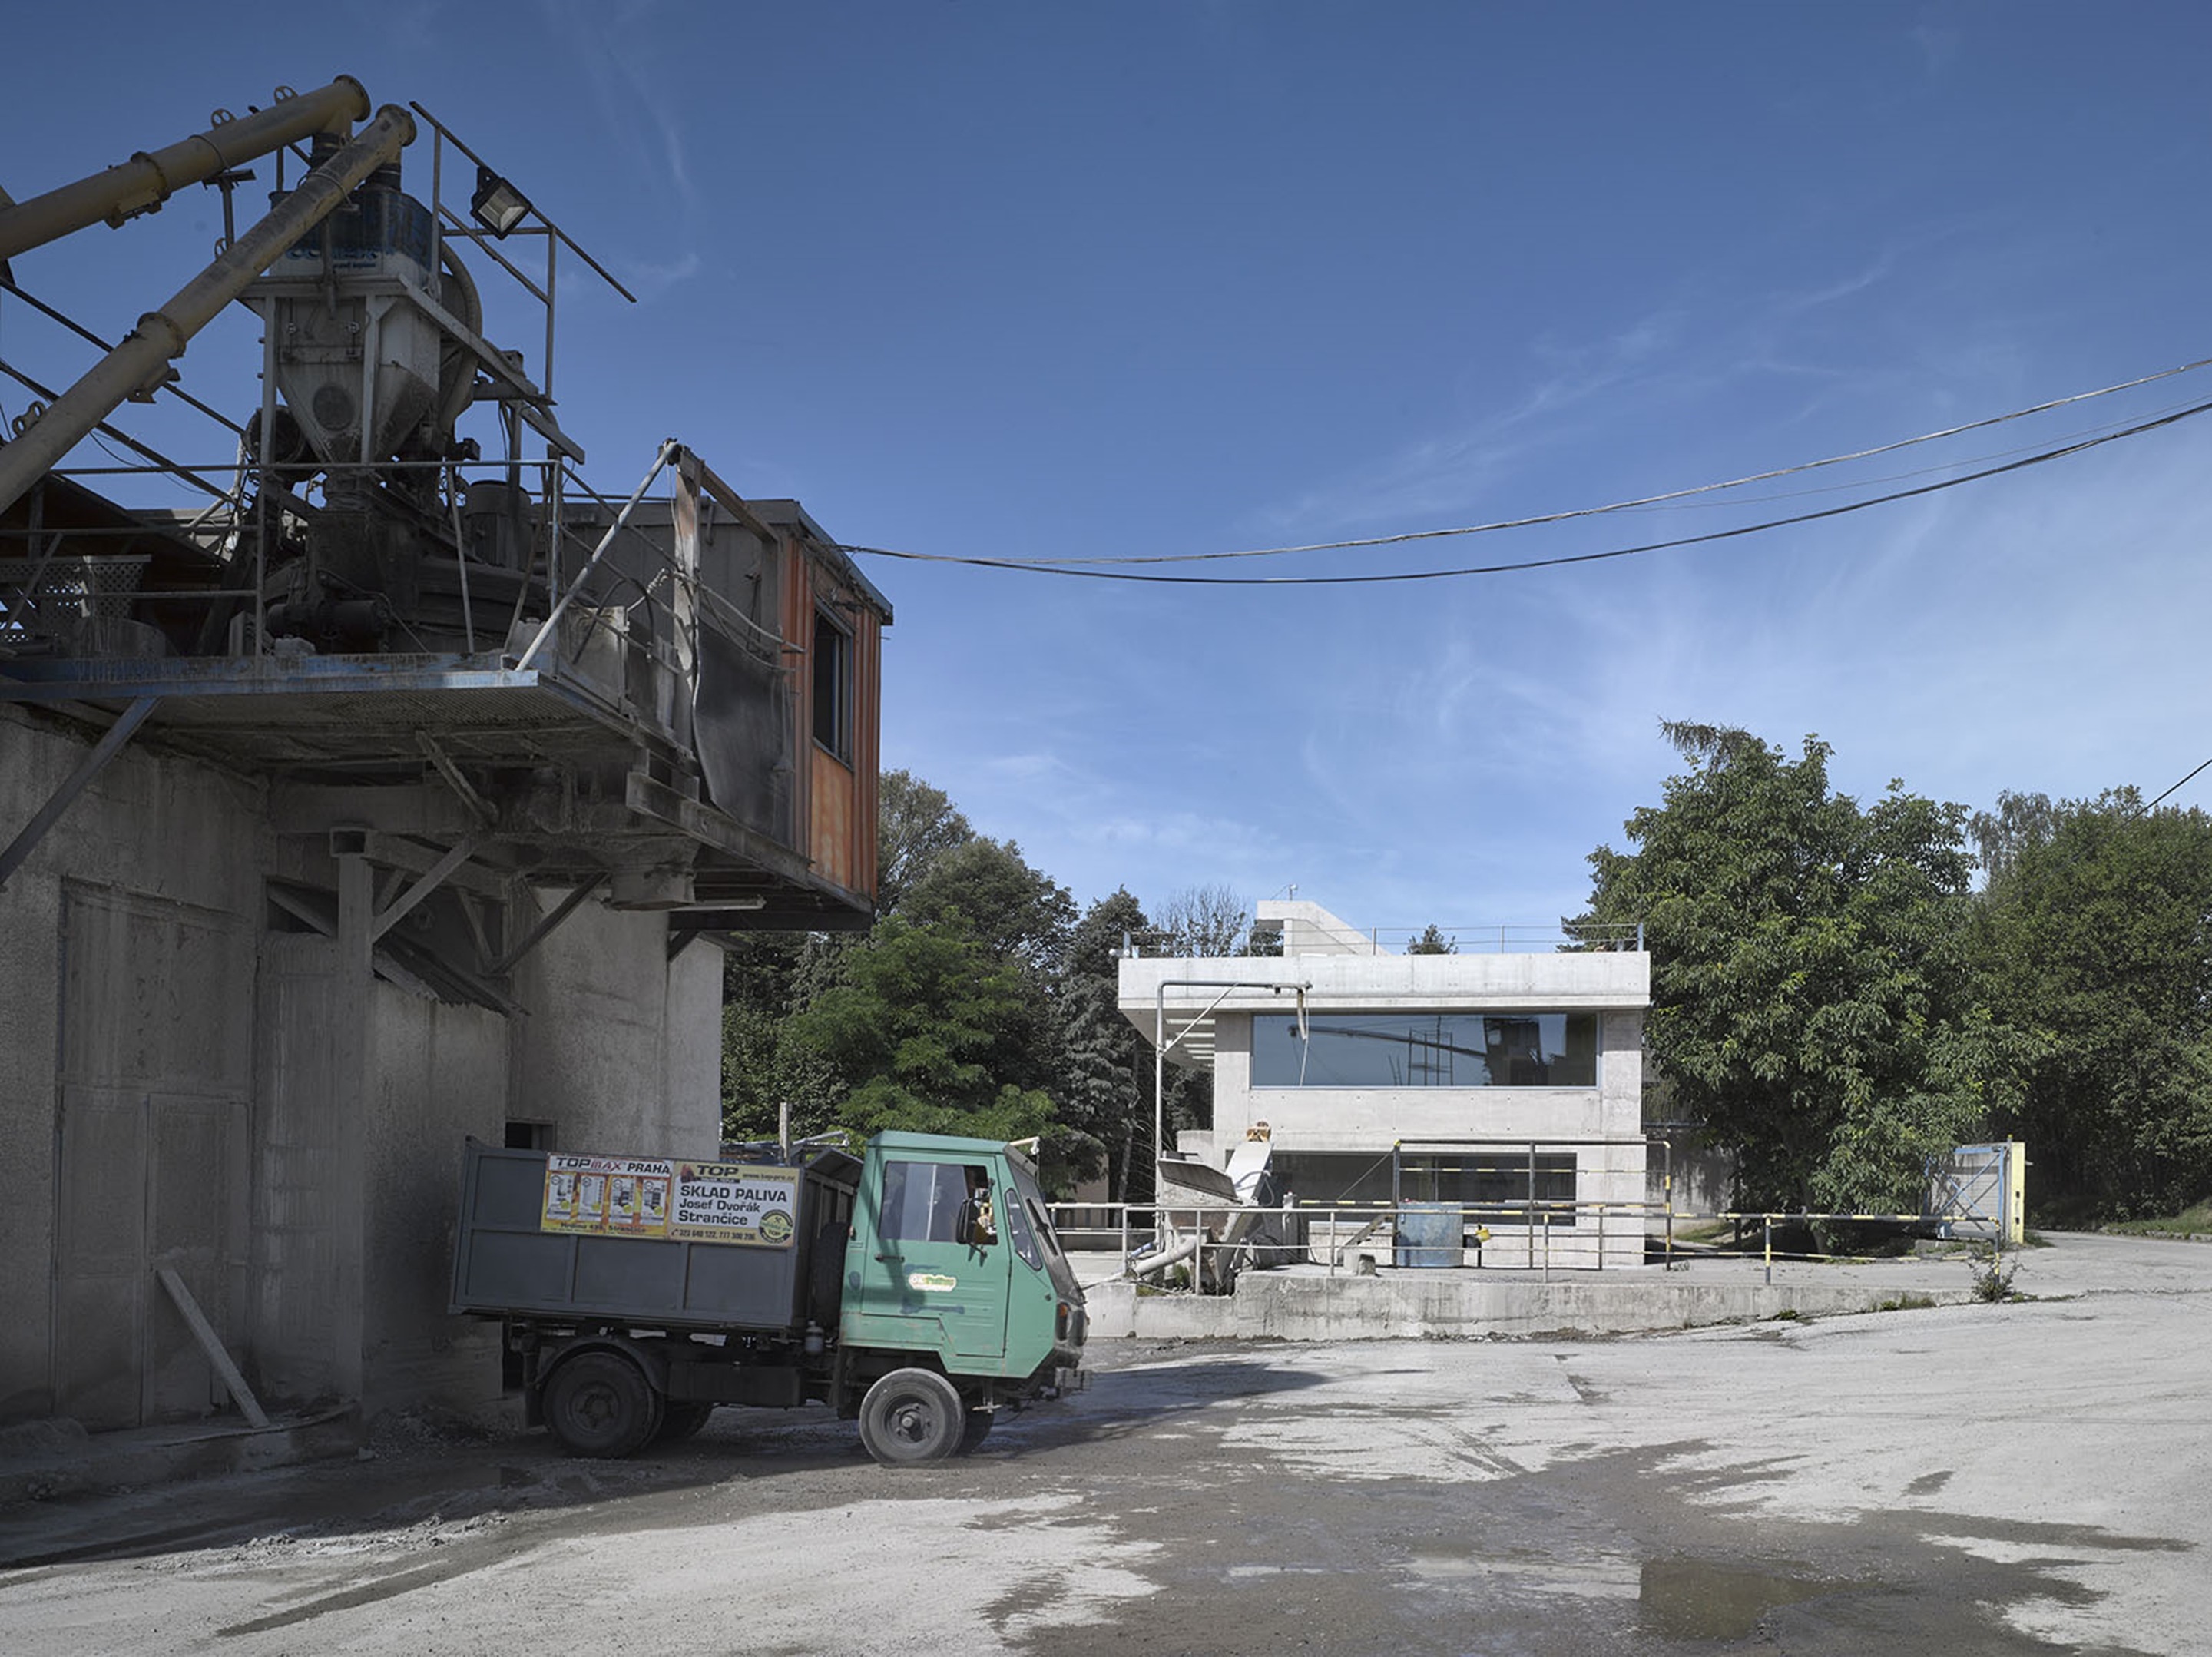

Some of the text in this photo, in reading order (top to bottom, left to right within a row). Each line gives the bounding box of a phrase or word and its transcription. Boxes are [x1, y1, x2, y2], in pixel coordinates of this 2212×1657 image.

[627, 1162, 671, 1174] PRAHA
[696, 1165, 739, 1176] TOP
[680, 1185, 787, 1202] SKLAD PALIVA
[679, 1198, 760, 1212] Josef Dvořák
[678, 1210, 747, 1225] Strančice
